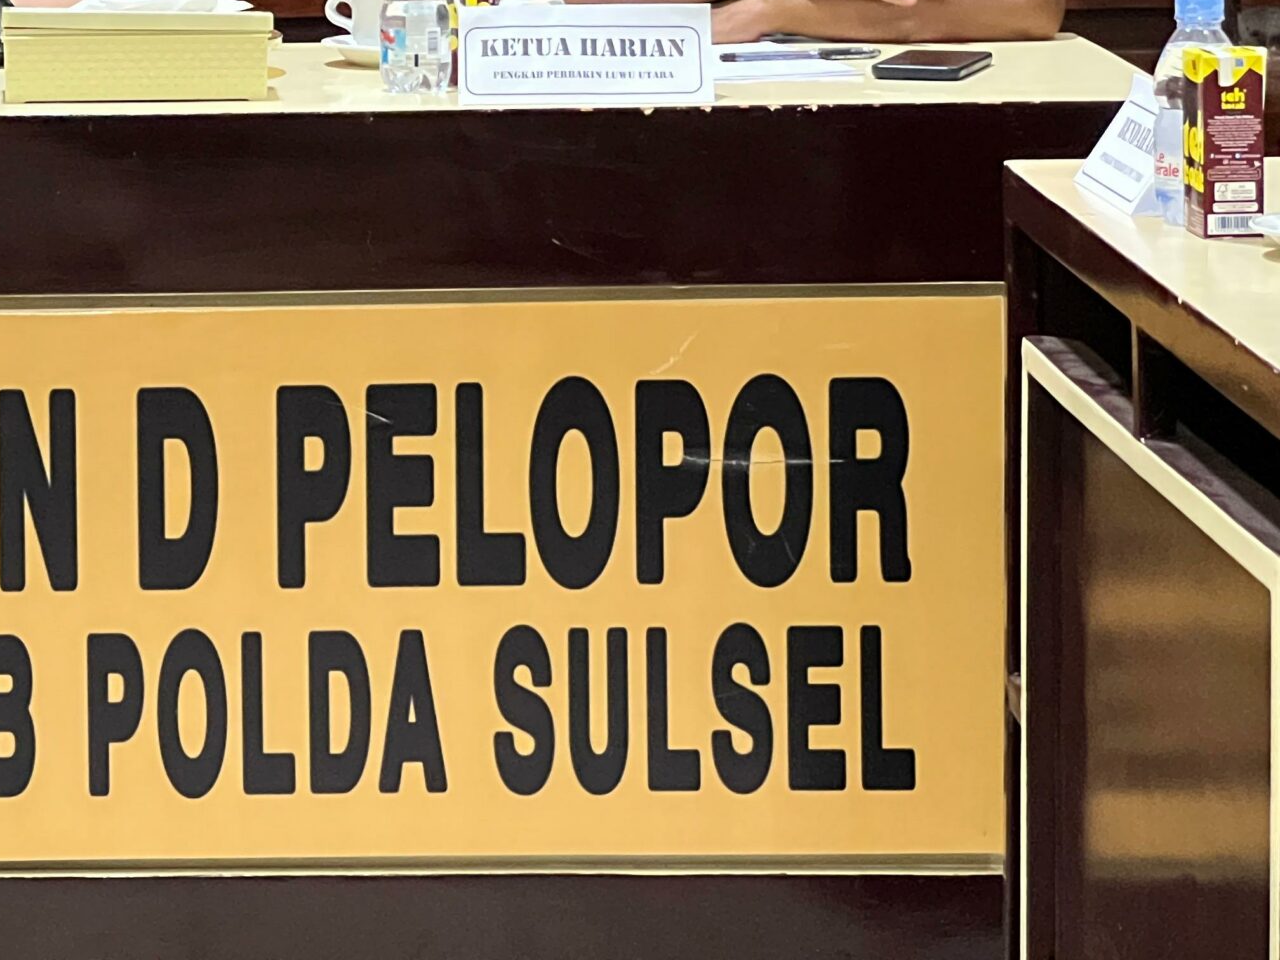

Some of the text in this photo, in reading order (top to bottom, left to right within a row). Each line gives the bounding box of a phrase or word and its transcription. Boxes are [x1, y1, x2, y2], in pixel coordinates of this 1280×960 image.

[480, 38, 685, 58] KETUA HARIAN
[493, 70, 544, 79] PENGKAB
[547, 70, 602, 79] PERBAKIN
[638, 71, 675, 79] UTARA
[136, 386, 219, 591] D
[276, 373, 913, 590] PELOPOR
[86, 628, 448, 799] POLDA
[493, 622, 917, 796] SULSEL
